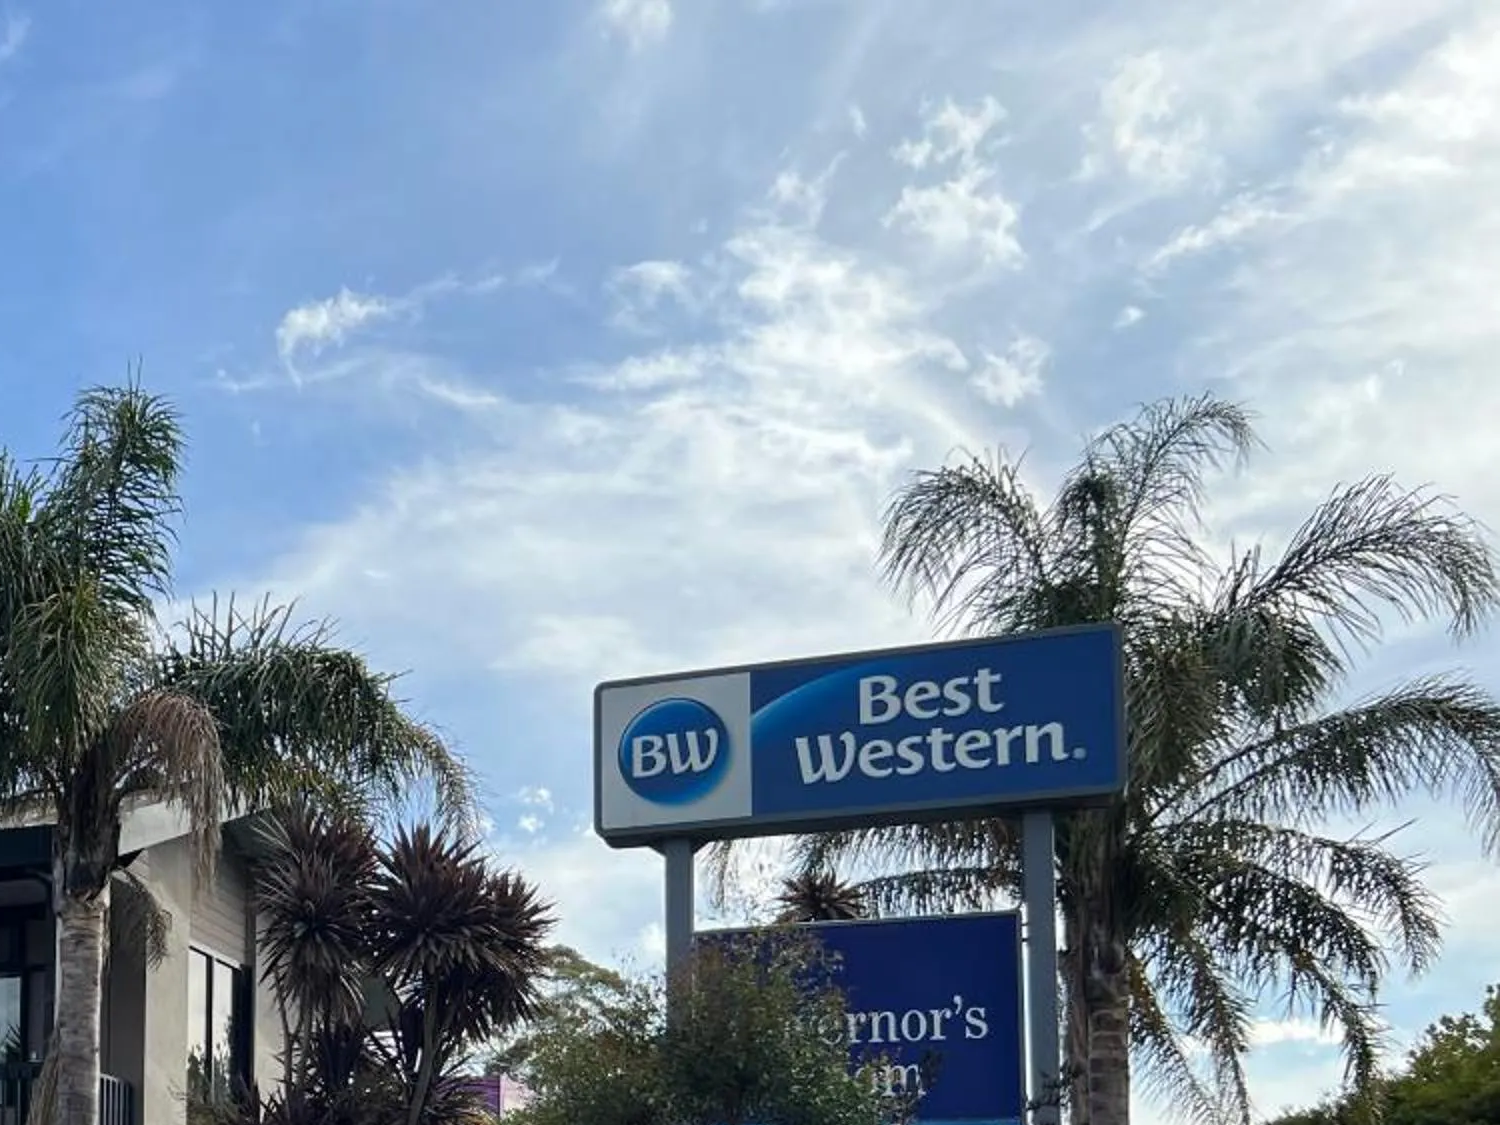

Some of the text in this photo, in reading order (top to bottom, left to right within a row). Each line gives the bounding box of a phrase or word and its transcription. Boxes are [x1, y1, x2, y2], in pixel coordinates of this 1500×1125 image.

[859, 667, 1005, 725] Best
[632, 727, 719, 779] BW
[816, 994, 990, 1046] ernor's
